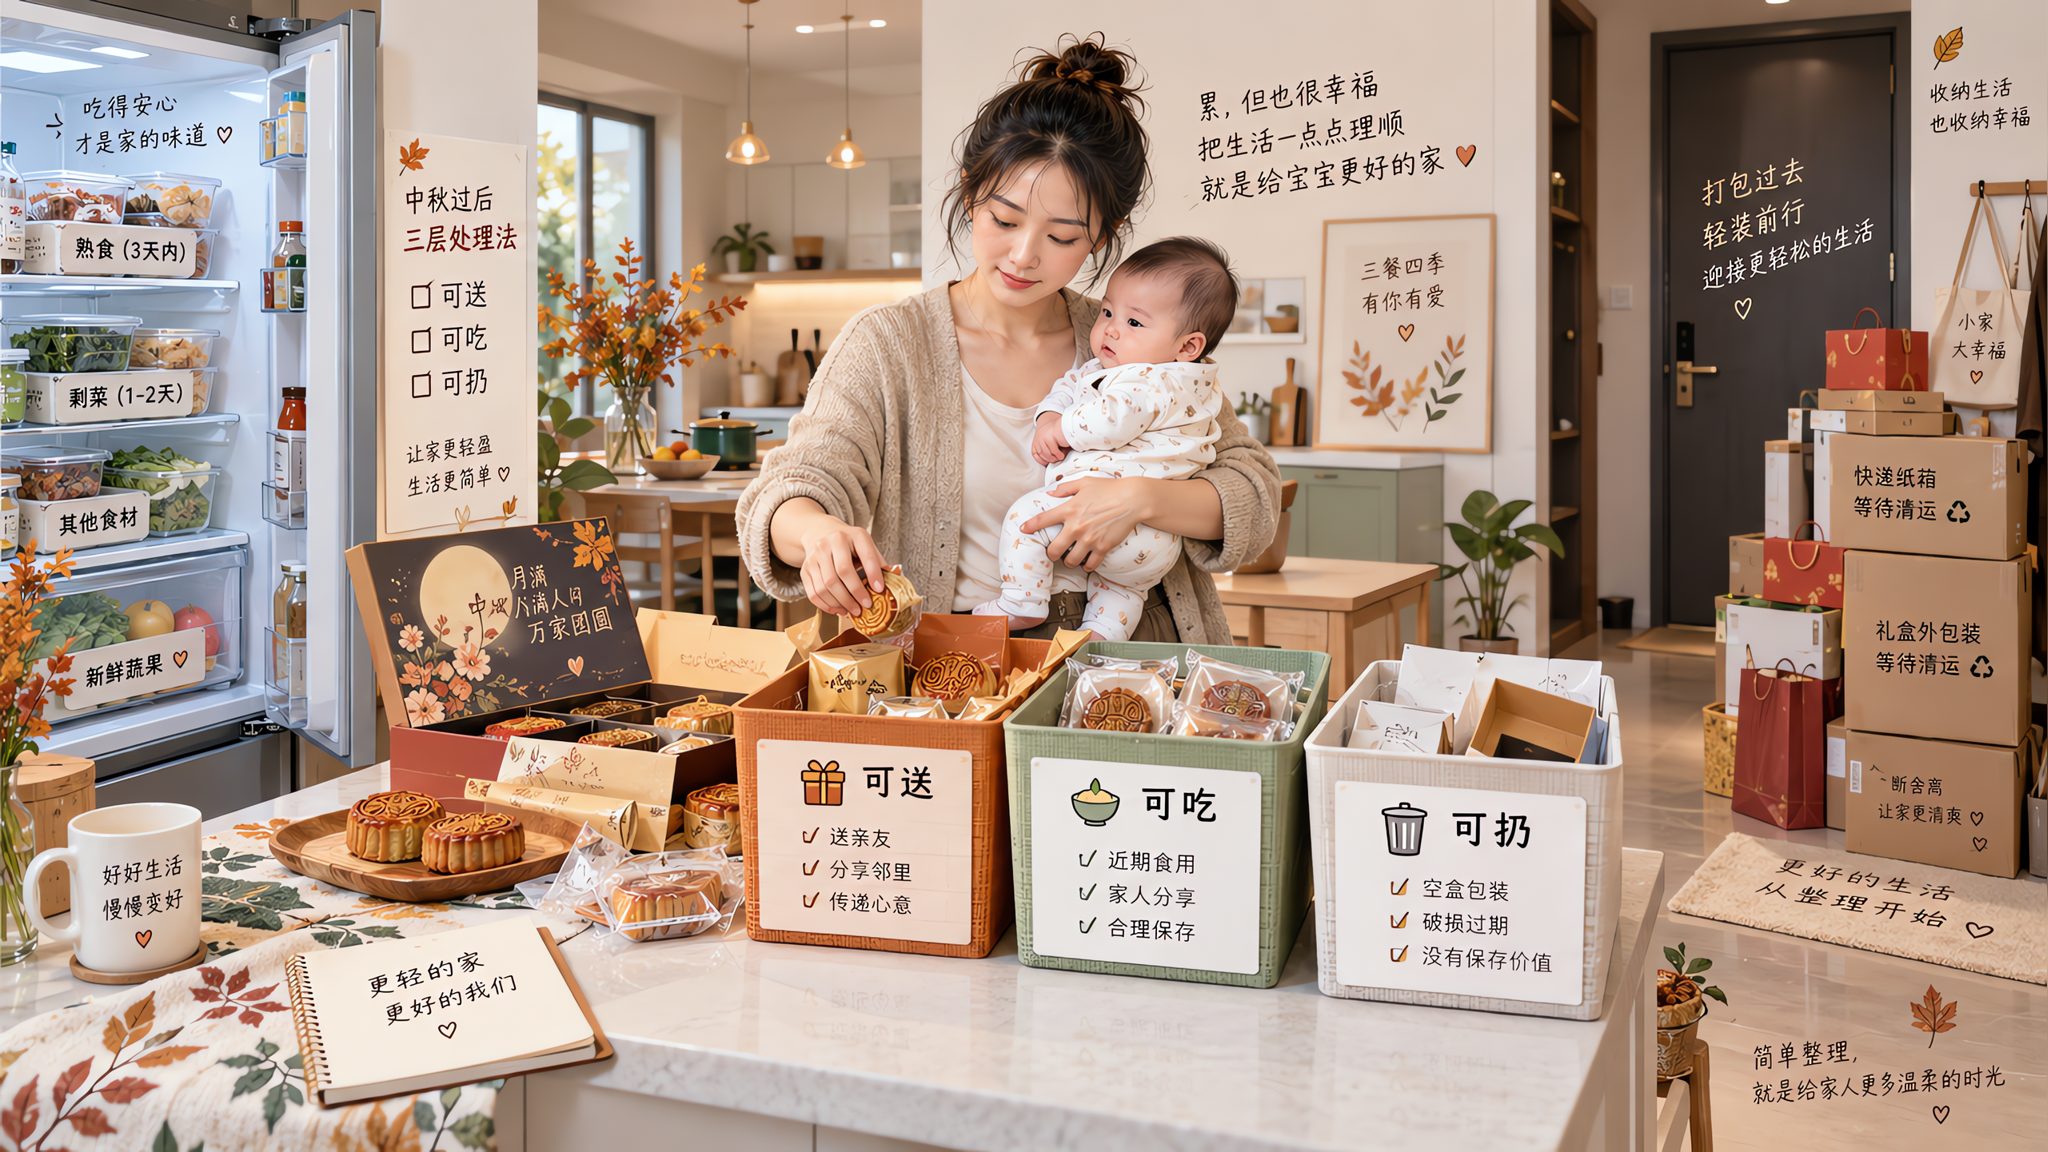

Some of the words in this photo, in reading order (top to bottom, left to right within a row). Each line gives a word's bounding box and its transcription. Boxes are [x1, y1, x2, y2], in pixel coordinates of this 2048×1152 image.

[406, 186, 492, 214] 中秋过后
[404, 223, 517, 252] 三层处理法
[1362, 252, 1444, 280] 三餐四季
[441, 281, 486, 308] 可送
[1363, 284, 1444, 314] 有你有爱
[1959, 312, 1992, 332] 小家
[442, 324, 487, 352] 可吃
[1953, 340, 2005, 360] 大幸福
[442, 368, 487, 396] 可扔
[406, 435, 493, 464] 让家更轻盈
[407, 465, 492, 497] 生活更简单
[1855, 465, 1936, 488] 快递纸箱
[60, 506, 137, 536] 其他食材
[1854, 496, 1936, 520] 等待清运
[526, 605, 612, 643] 万家团圆
[1876, 620, 1980, 644] 礼盒外包装
[86, 654, 162, 687] 新鲜蔬果
[1877, 652, 1959, 675] 等待清运
[863, 766, 933, 799] 可送
[1142, 788, 1216, 822] 可吃
[1879, 804, 1961, 825] 让家更清爽
[830, 827, 890, 848] 送亲友
[1452, 812, 1530, 848] 可扔
[103, 855, 182, 885] 好好生活
[830, 860, 911, 881] 分享邻里
[1109, 851, 1194, 874] 近期食用
[1424, 878, 1508, 901] 空盒包装
[1775, 859, 1955, 902] 更好的生活
[103, 889, 183, 920] 慢慢变好
[830, 892, 911, 914] 传递心意
[1109, 884, 1195, 908] 家人分享
[1755, 881, 1948, 927] 从整理开始
[1108, 918, 1194, 942] 合理保存
[1423, 912, 1507, 935] 破损过期
[1423, 946, 1552, 972] 没有保存价值
[368, 950, 485, 997] 更轻的家
[386, 974, 517, 1026] 更好的我们
